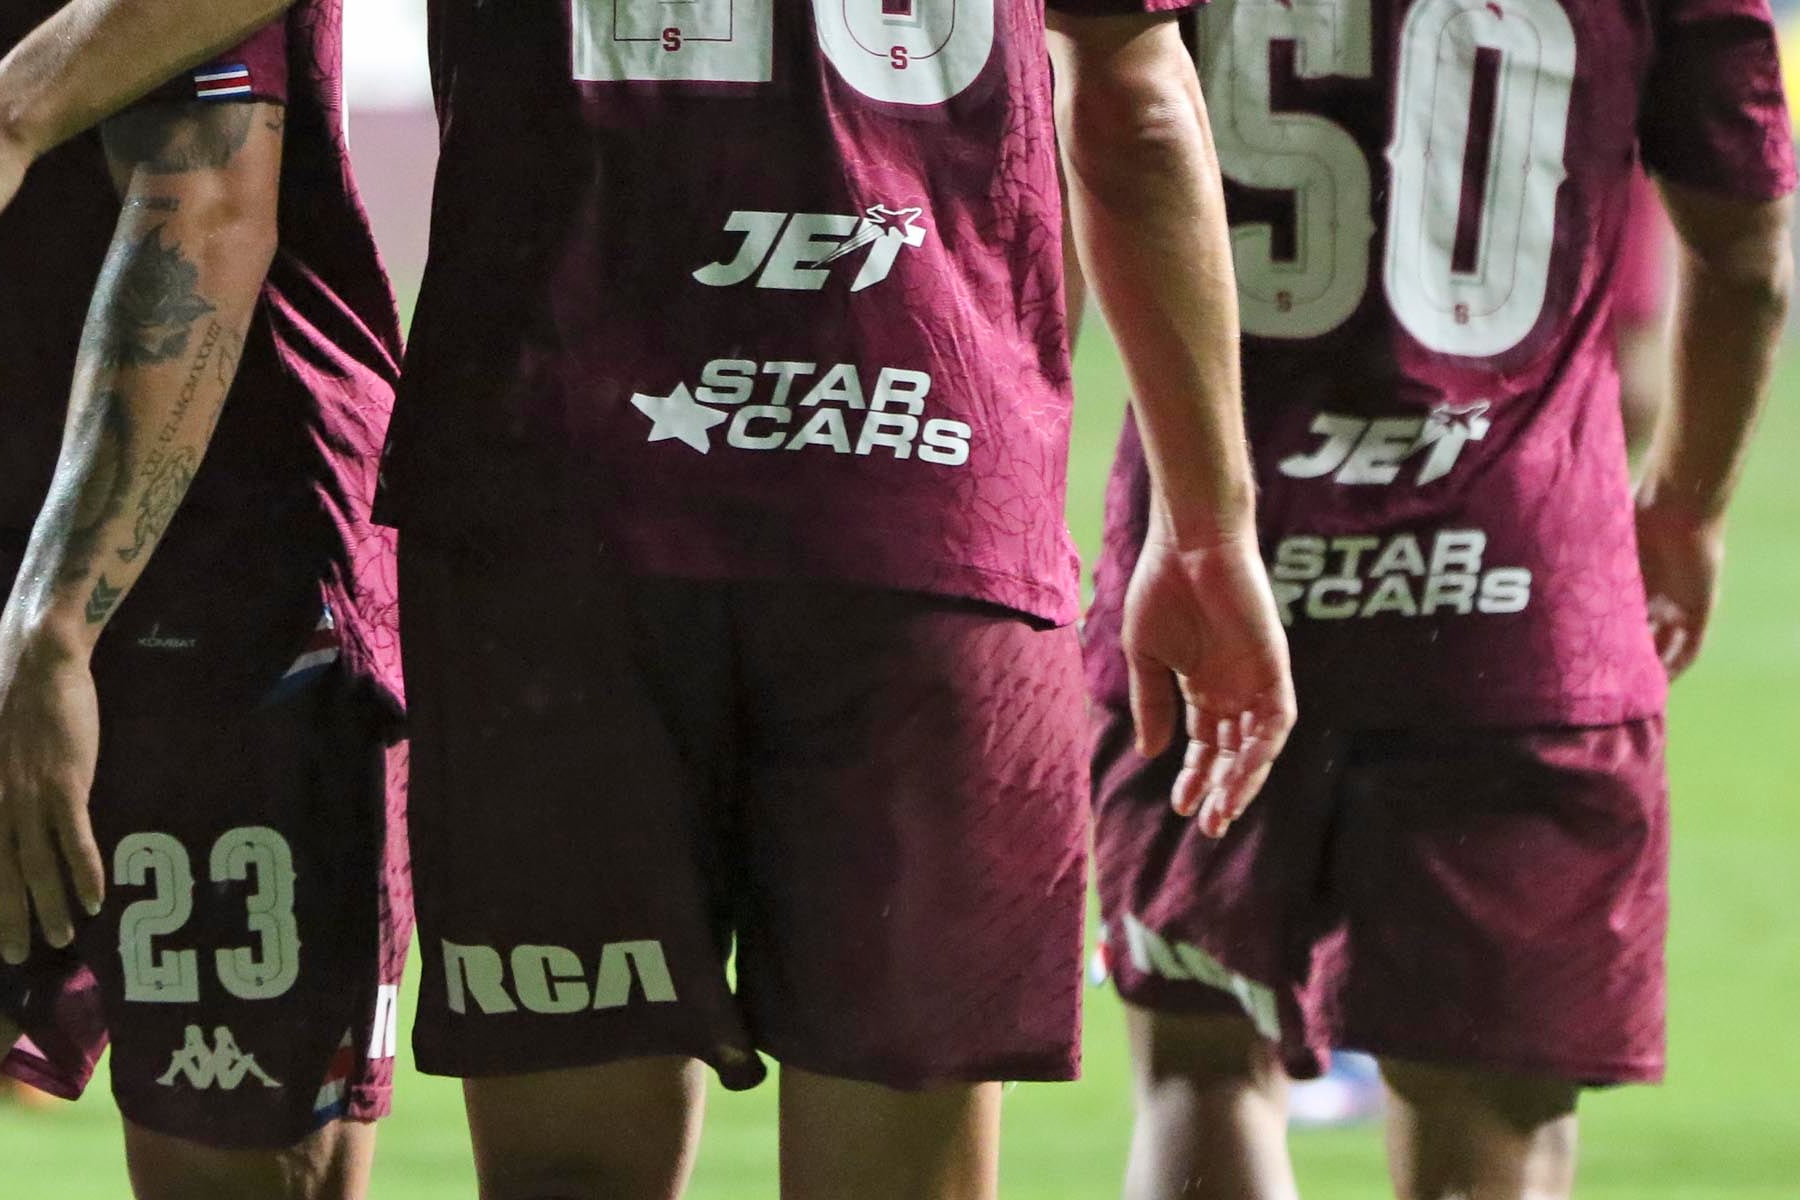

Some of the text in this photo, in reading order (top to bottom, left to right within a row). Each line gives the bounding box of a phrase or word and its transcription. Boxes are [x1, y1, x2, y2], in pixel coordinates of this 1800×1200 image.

[662, 27, 681, 51] S
[890, 46, 908, 70] S
[693, 204, 927, 293] JET
[695, 359, 932, 416] STAR
[726, 405, 972, 466] CARS
[1273, 530, 1487, 581] STAR
[1305, 568, 1532, 620] CARS
[113, 826, 301, 1002] 23
[441, 939, 677, 1015] RCA
